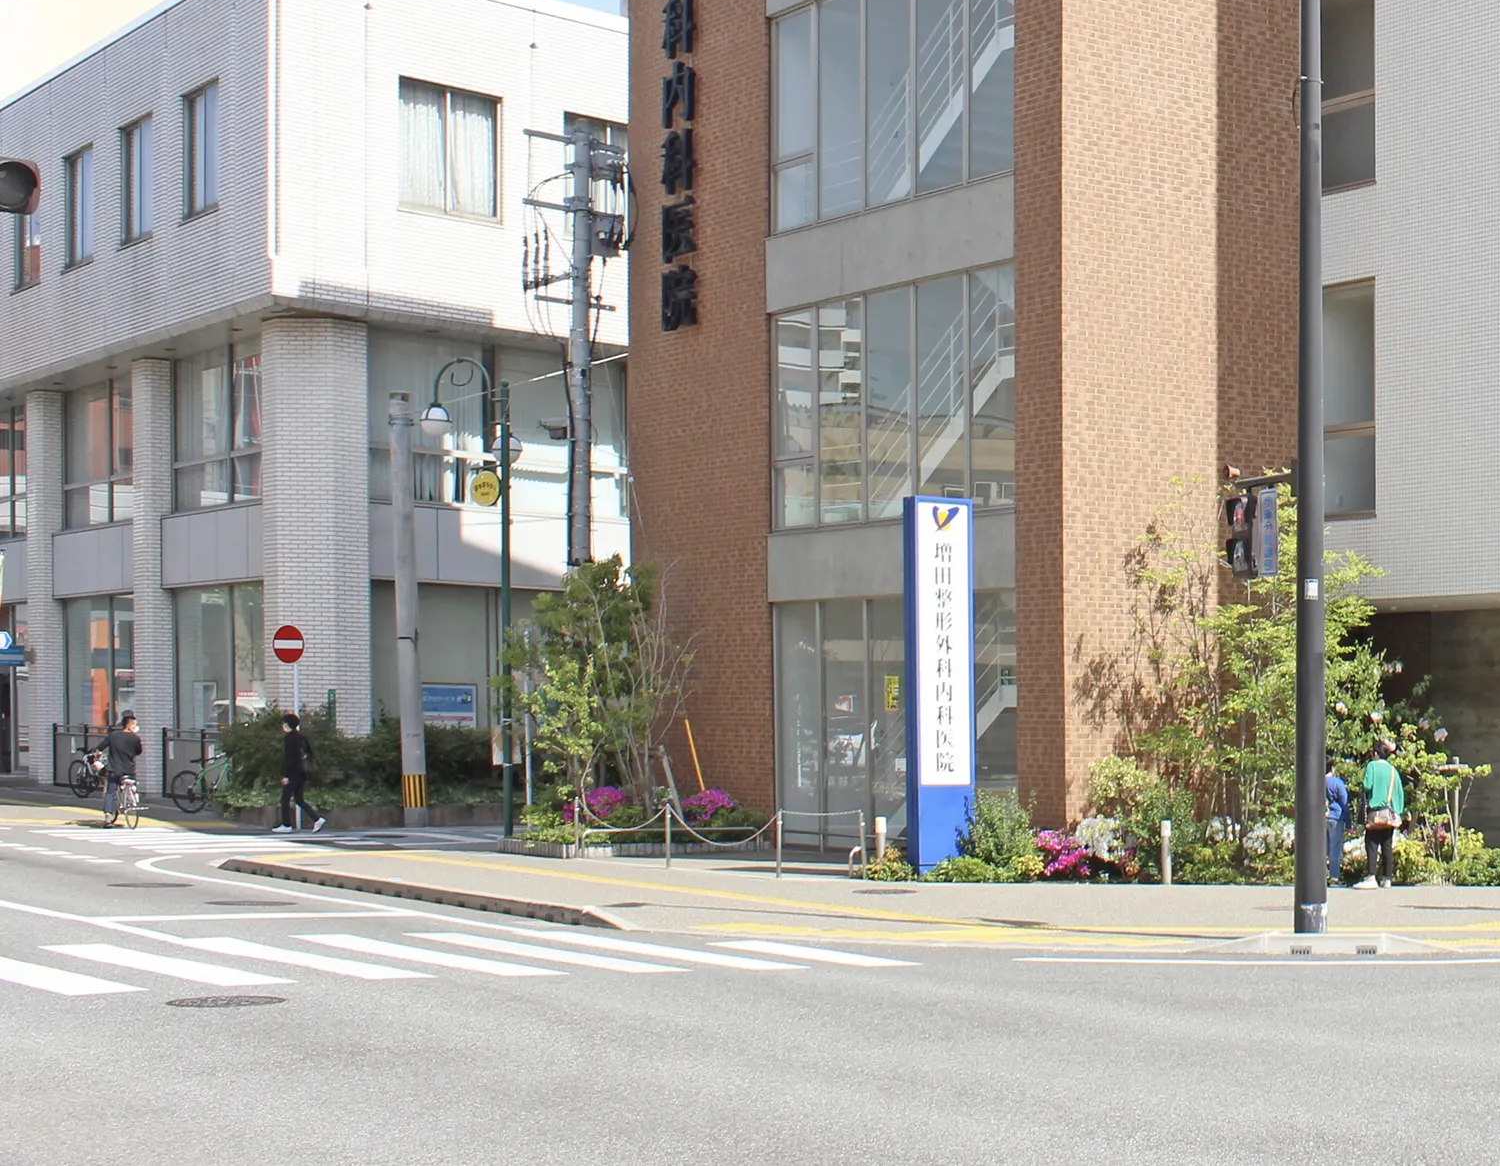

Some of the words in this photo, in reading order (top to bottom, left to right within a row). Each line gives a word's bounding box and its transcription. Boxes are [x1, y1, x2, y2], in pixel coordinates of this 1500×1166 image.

[933, 541, 956, 773] 増田整形外科内科医院
